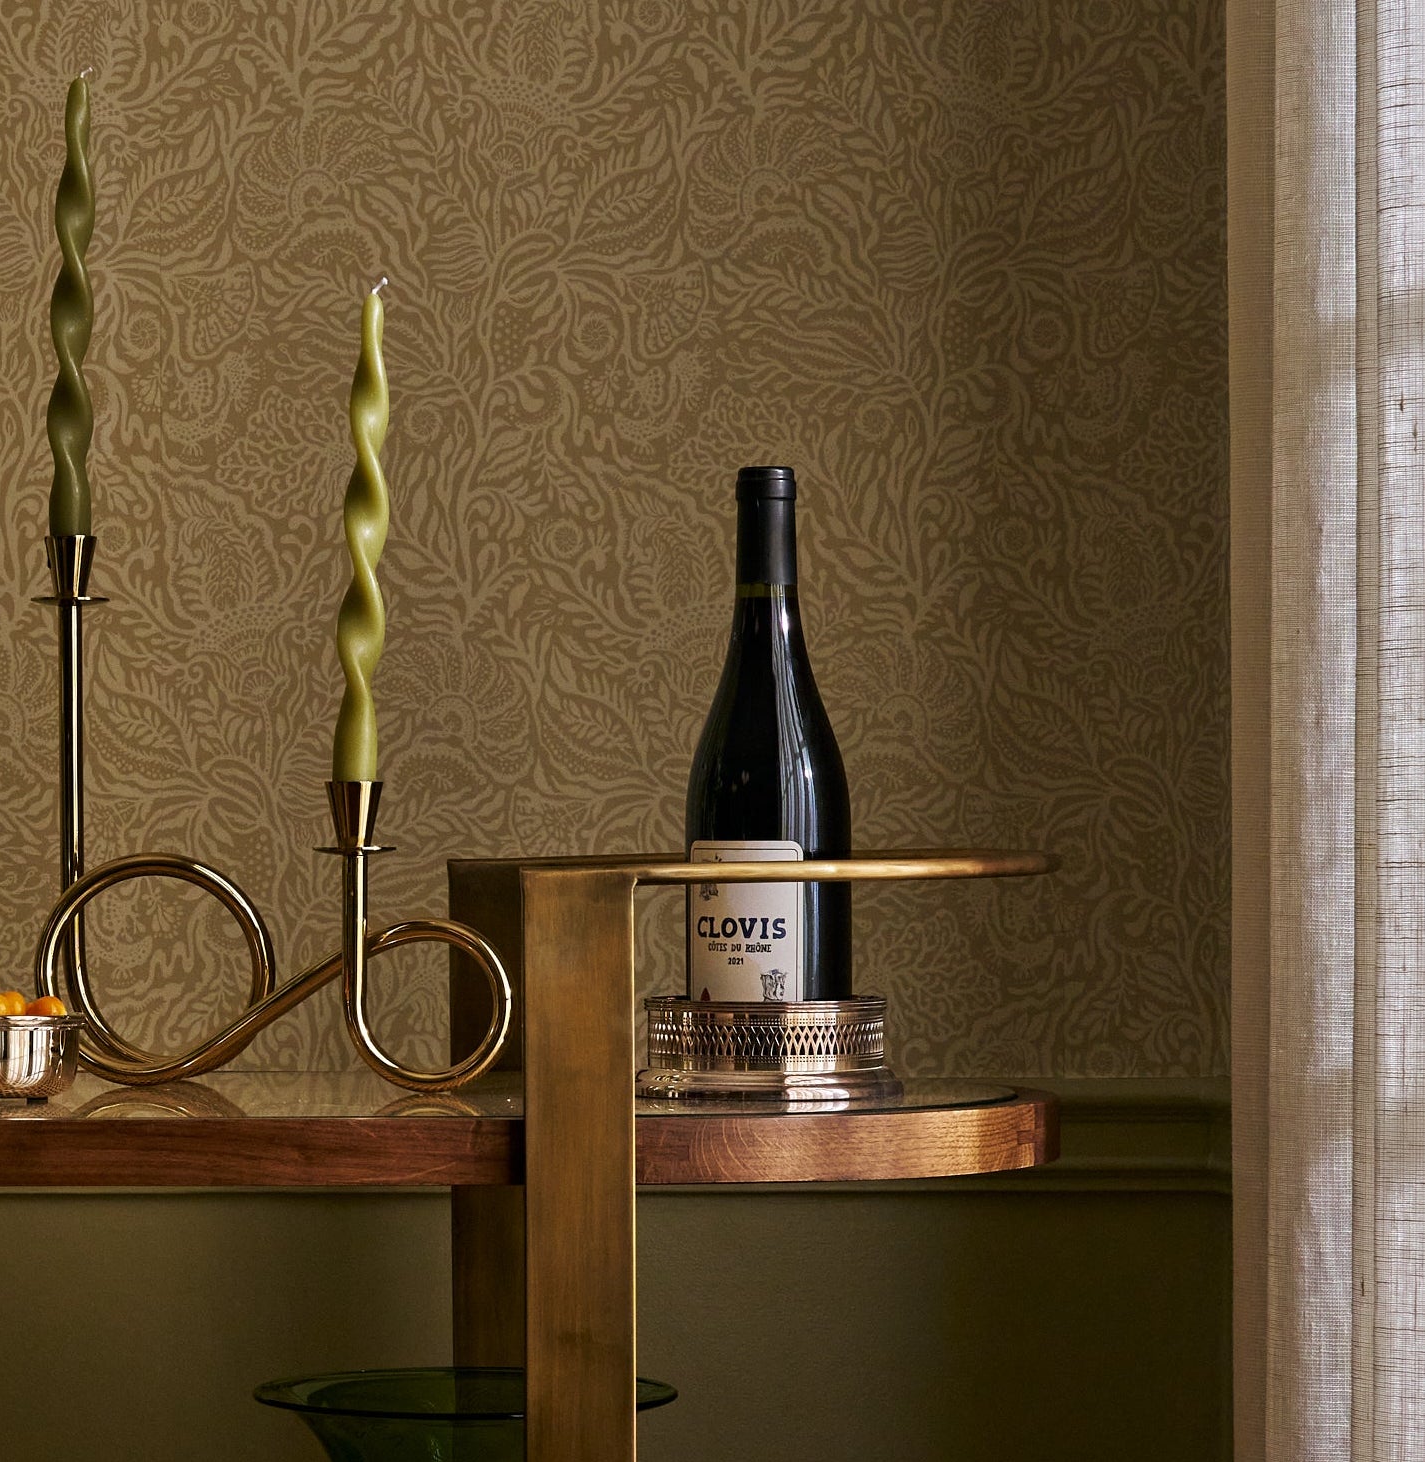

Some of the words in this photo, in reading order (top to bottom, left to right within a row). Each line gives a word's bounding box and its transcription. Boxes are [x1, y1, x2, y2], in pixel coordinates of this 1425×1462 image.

[698, 916, 786, 939] CLOVIS
[708, 941, 728, 952] CÔTES
[731, 943, 742, 952] DU
[744, 942, 772, 953] RHÔNE
[727, 957, 744, 965] 2021
